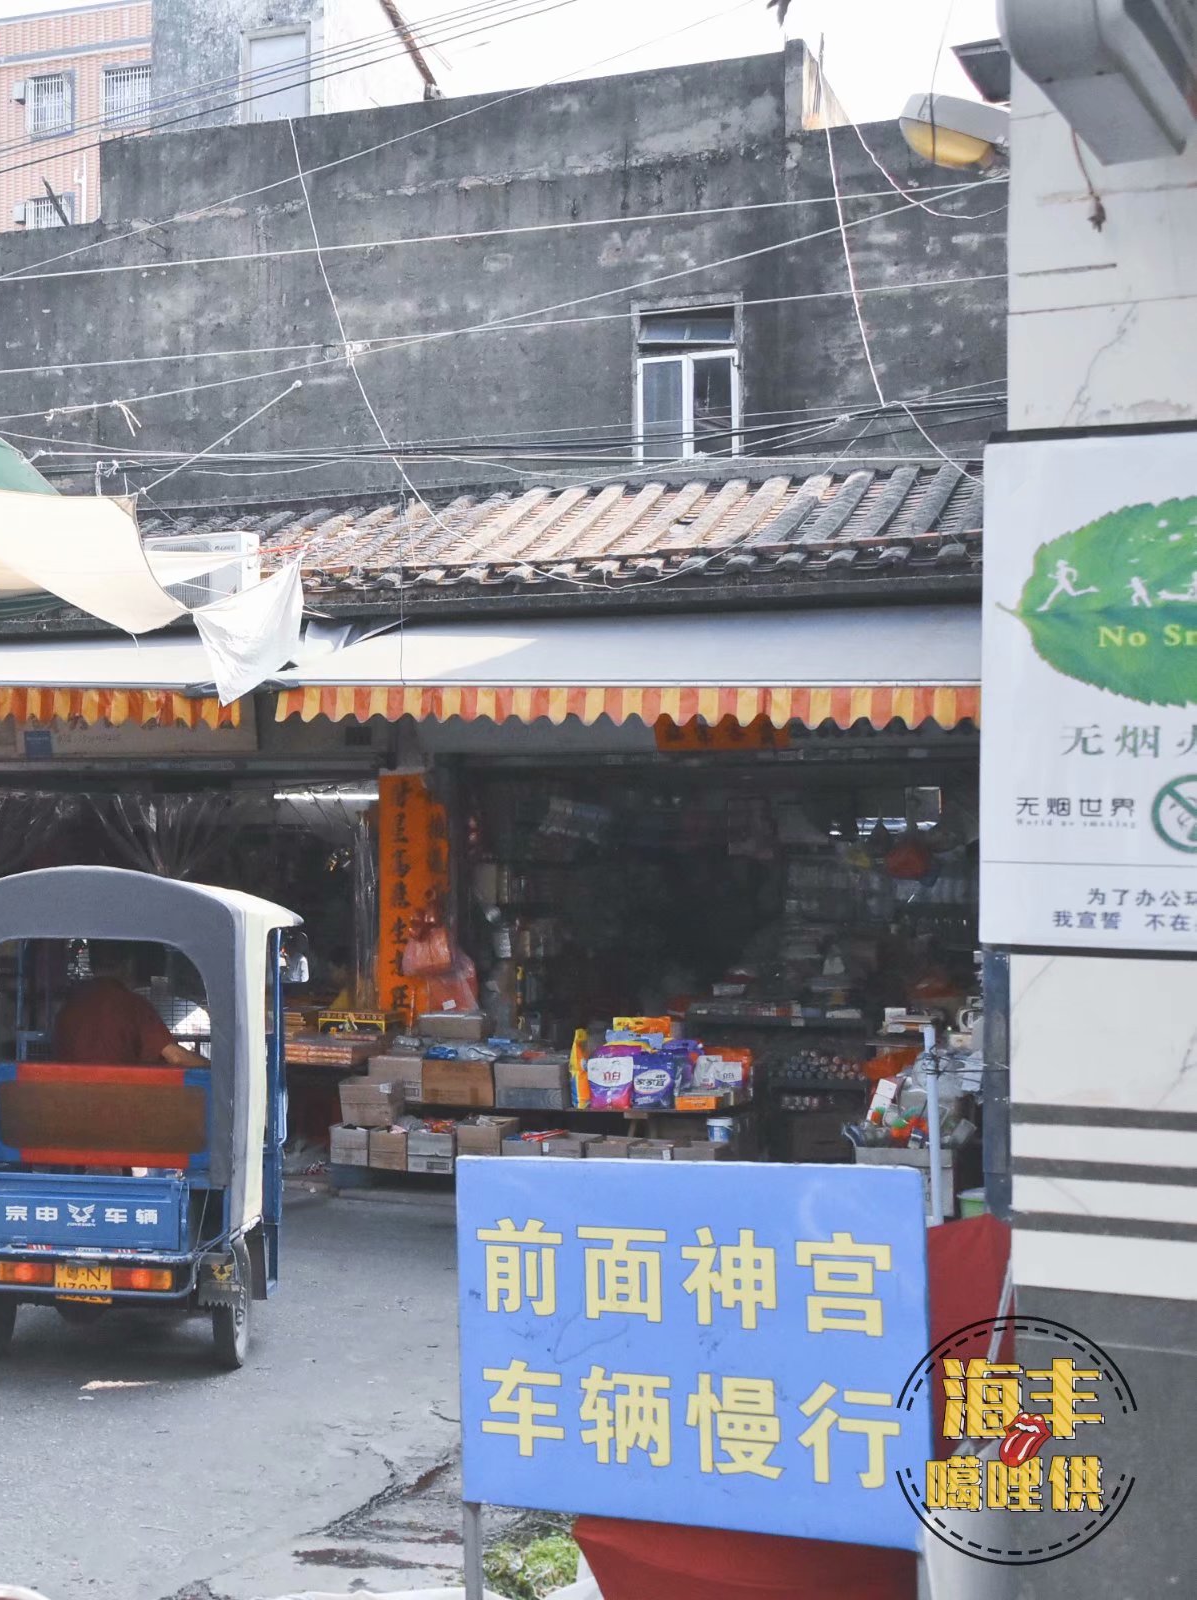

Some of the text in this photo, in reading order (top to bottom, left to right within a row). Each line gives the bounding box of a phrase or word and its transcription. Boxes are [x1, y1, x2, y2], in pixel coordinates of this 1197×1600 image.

[1098, 625, 1147, 648] No
[1016, 797, 1135, 818] 无烟世界
[1052, 909, 1197, 932] 我宣誓 不在
[5, 1205, 158, 1225] 宗申 车辆
[476, 1217, 892, 1338] 前面神宫
[481, 1358, 901, 1490] 车辆慢行
